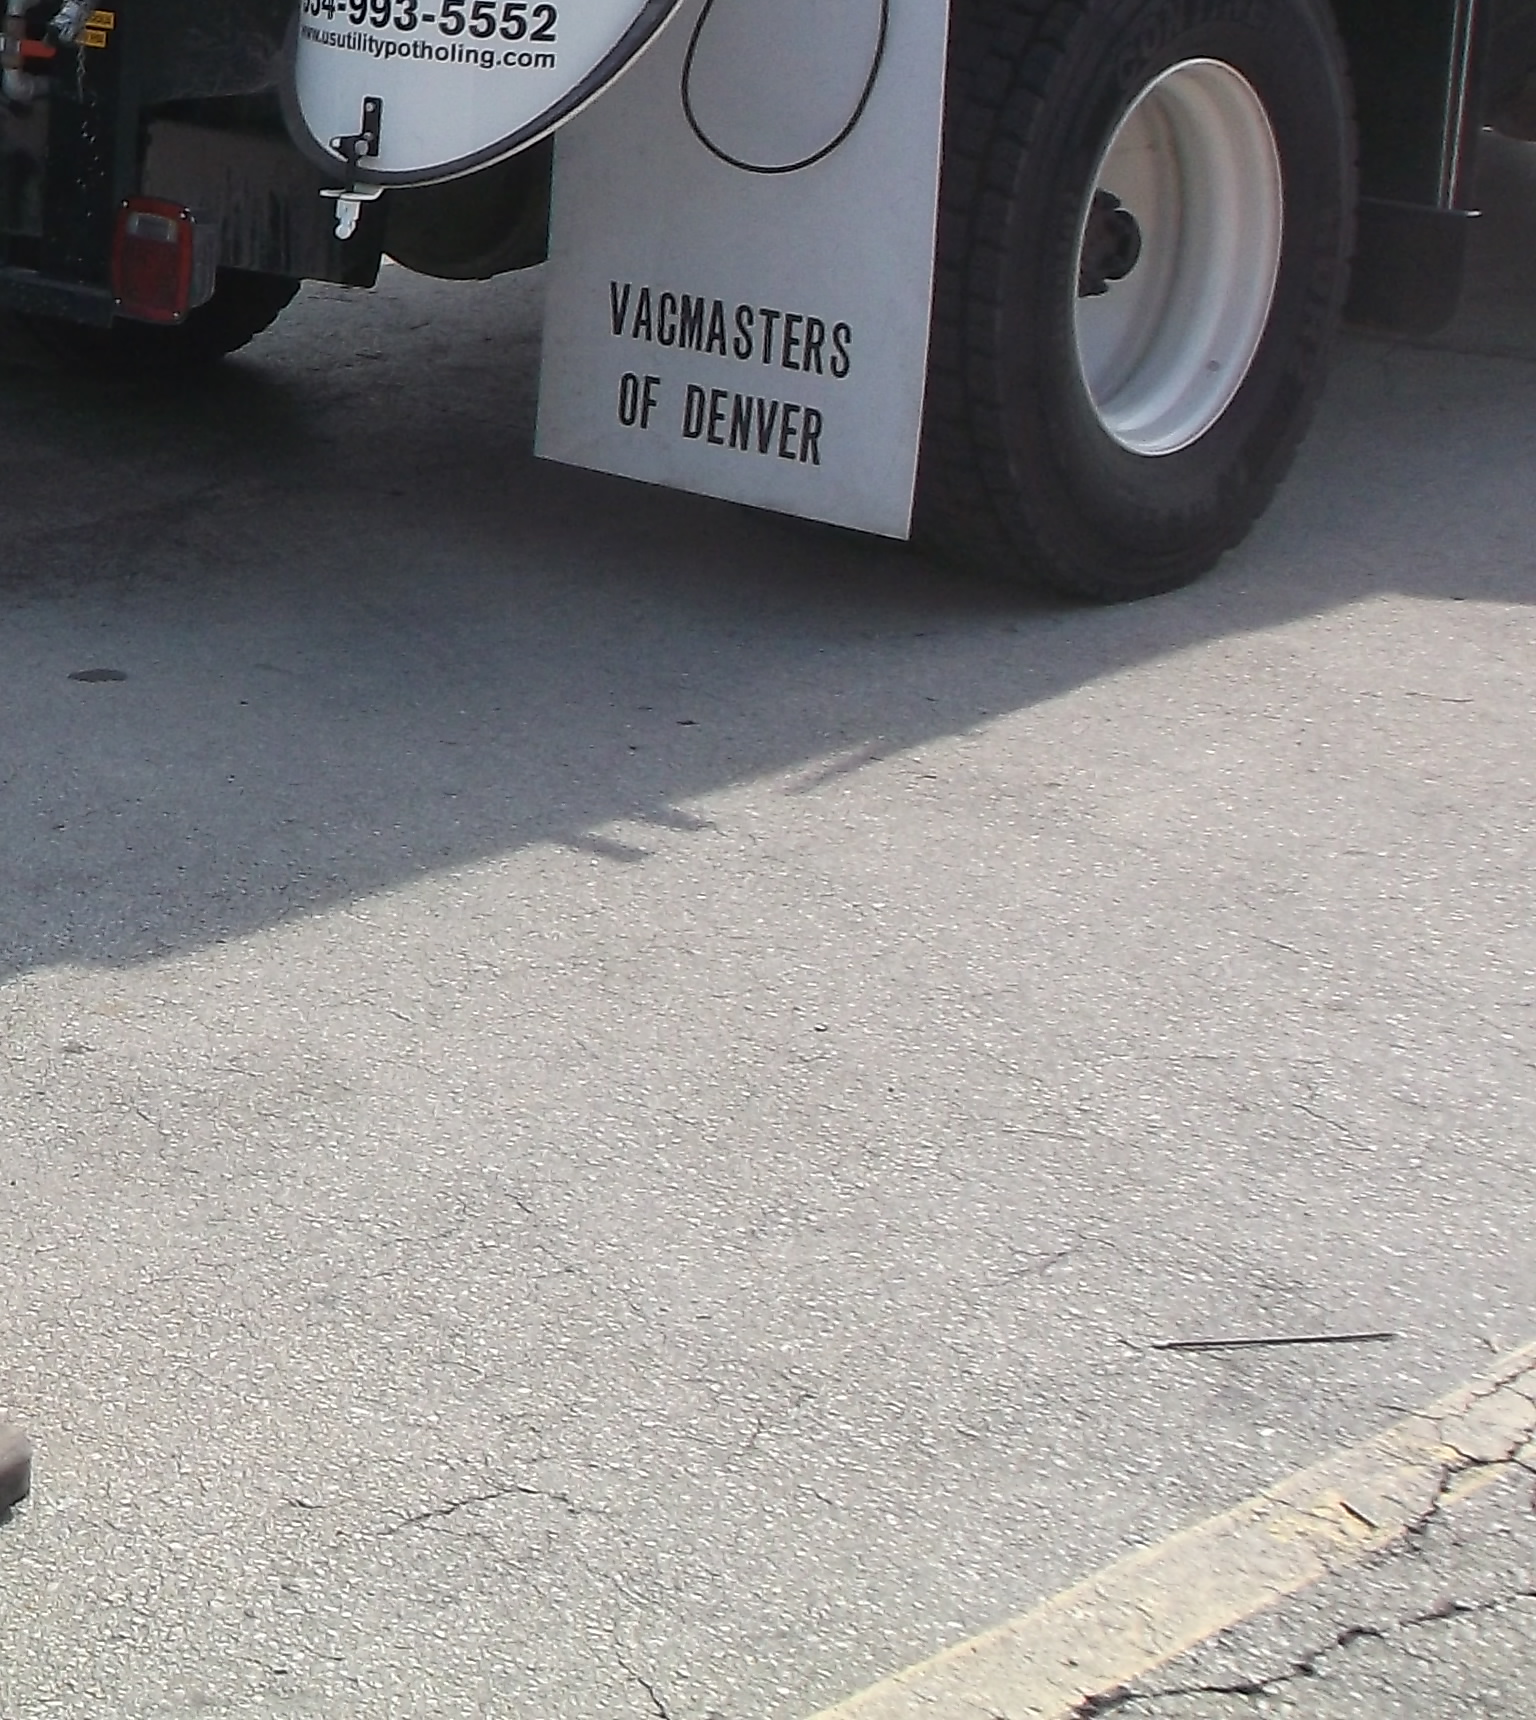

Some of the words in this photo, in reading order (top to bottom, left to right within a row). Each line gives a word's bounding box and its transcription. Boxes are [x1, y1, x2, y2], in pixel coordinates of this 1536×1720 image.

[299, 24, 556, 69] www.usutilitypotholing.com
[610, 281, 852, 379] VACMASTERS
[619, 372, 661, 429] OF
[682, 383, 824, 466] DENVER
